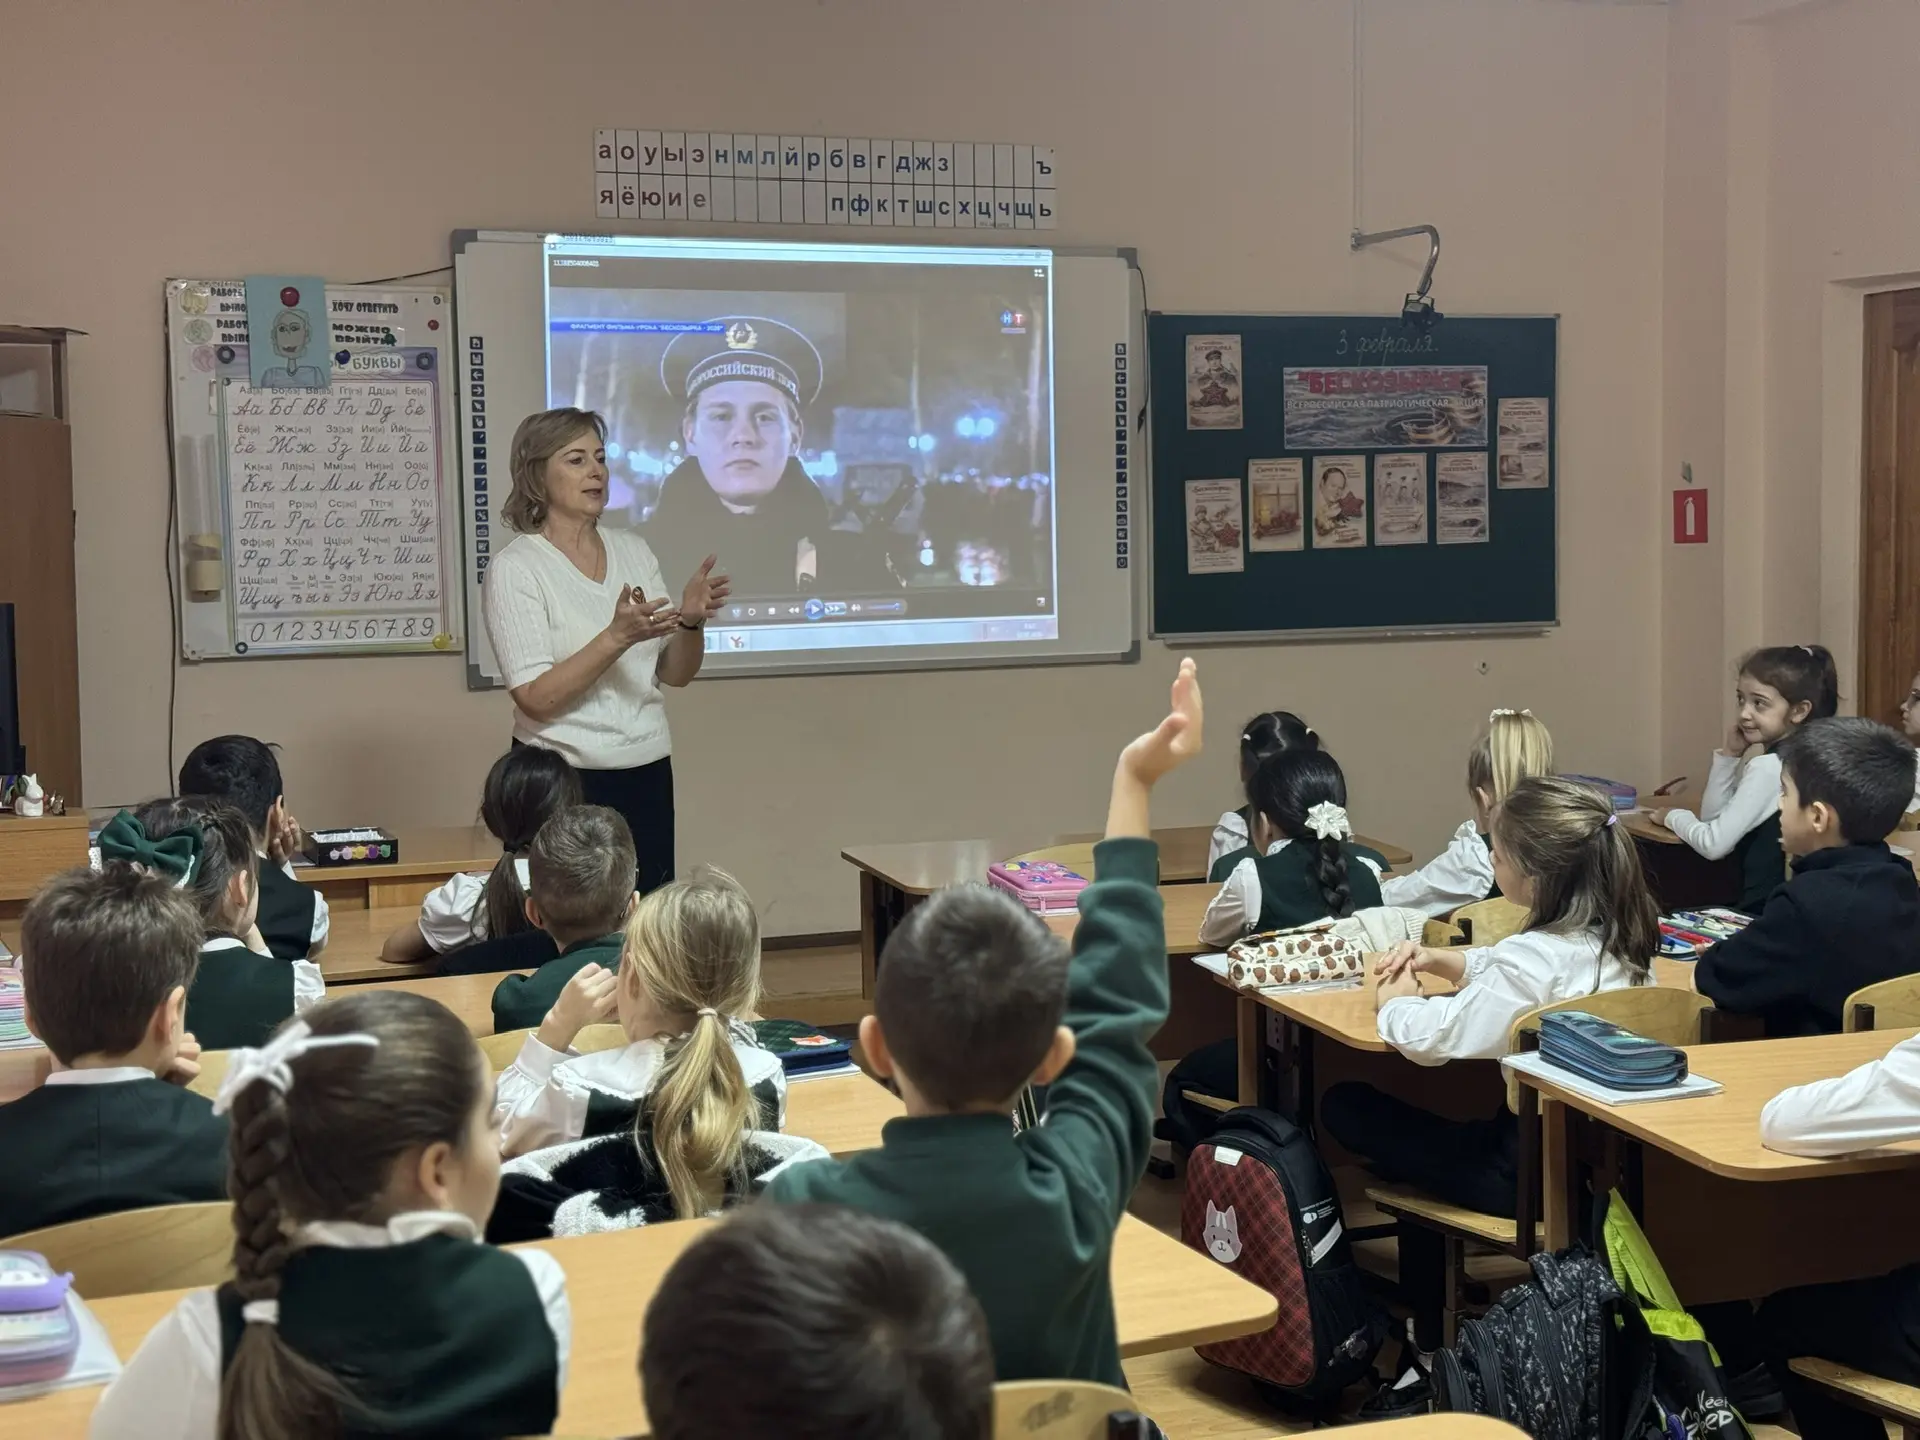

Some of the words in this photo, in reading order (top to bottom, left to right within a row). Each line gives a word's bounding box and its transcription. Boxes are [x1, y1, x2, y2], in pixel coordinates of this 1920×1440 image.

[332, 300, 354, 311] ХОЧУ
[357, 301, 398, 314] ОТВЕТИТЬ
[332, 323, 391, 334] МОЖНО
[1336, 329, 1348, 355] 3
[353, 356, 400, 369] БУКВЫ
[1368, 399, 1448, 408] ПАТРИОТИЧЕСКАЯ
